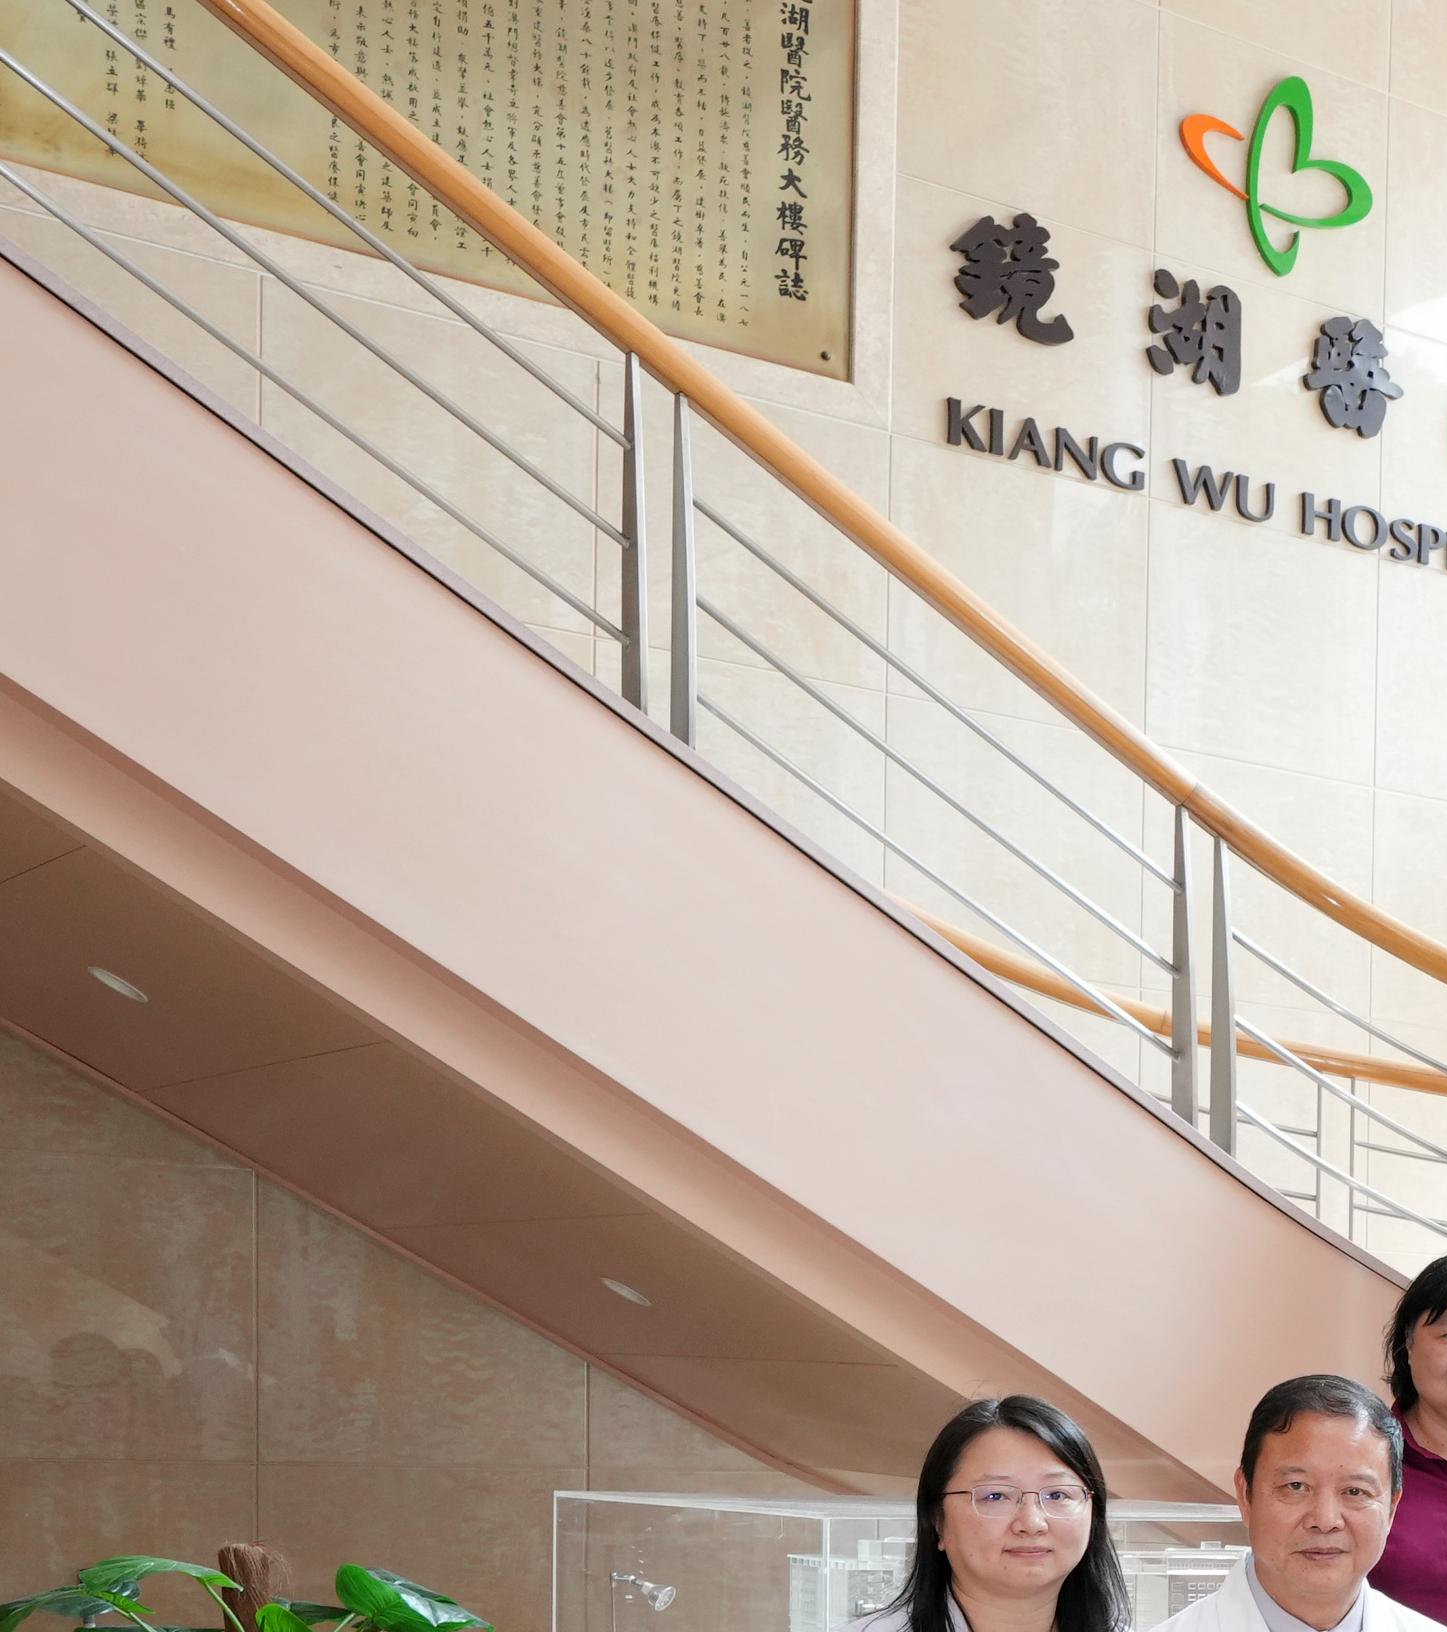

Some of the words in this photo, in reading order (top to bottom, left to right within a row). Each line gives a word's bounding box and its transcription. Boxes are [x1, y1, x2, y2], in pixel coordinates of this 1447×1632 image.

[775, 0, 814, 301] 湖醫院醫務大樓碑誌
[946, 397, 1145, 492] KIANG
[1172, 457, 1276, 523] WU
